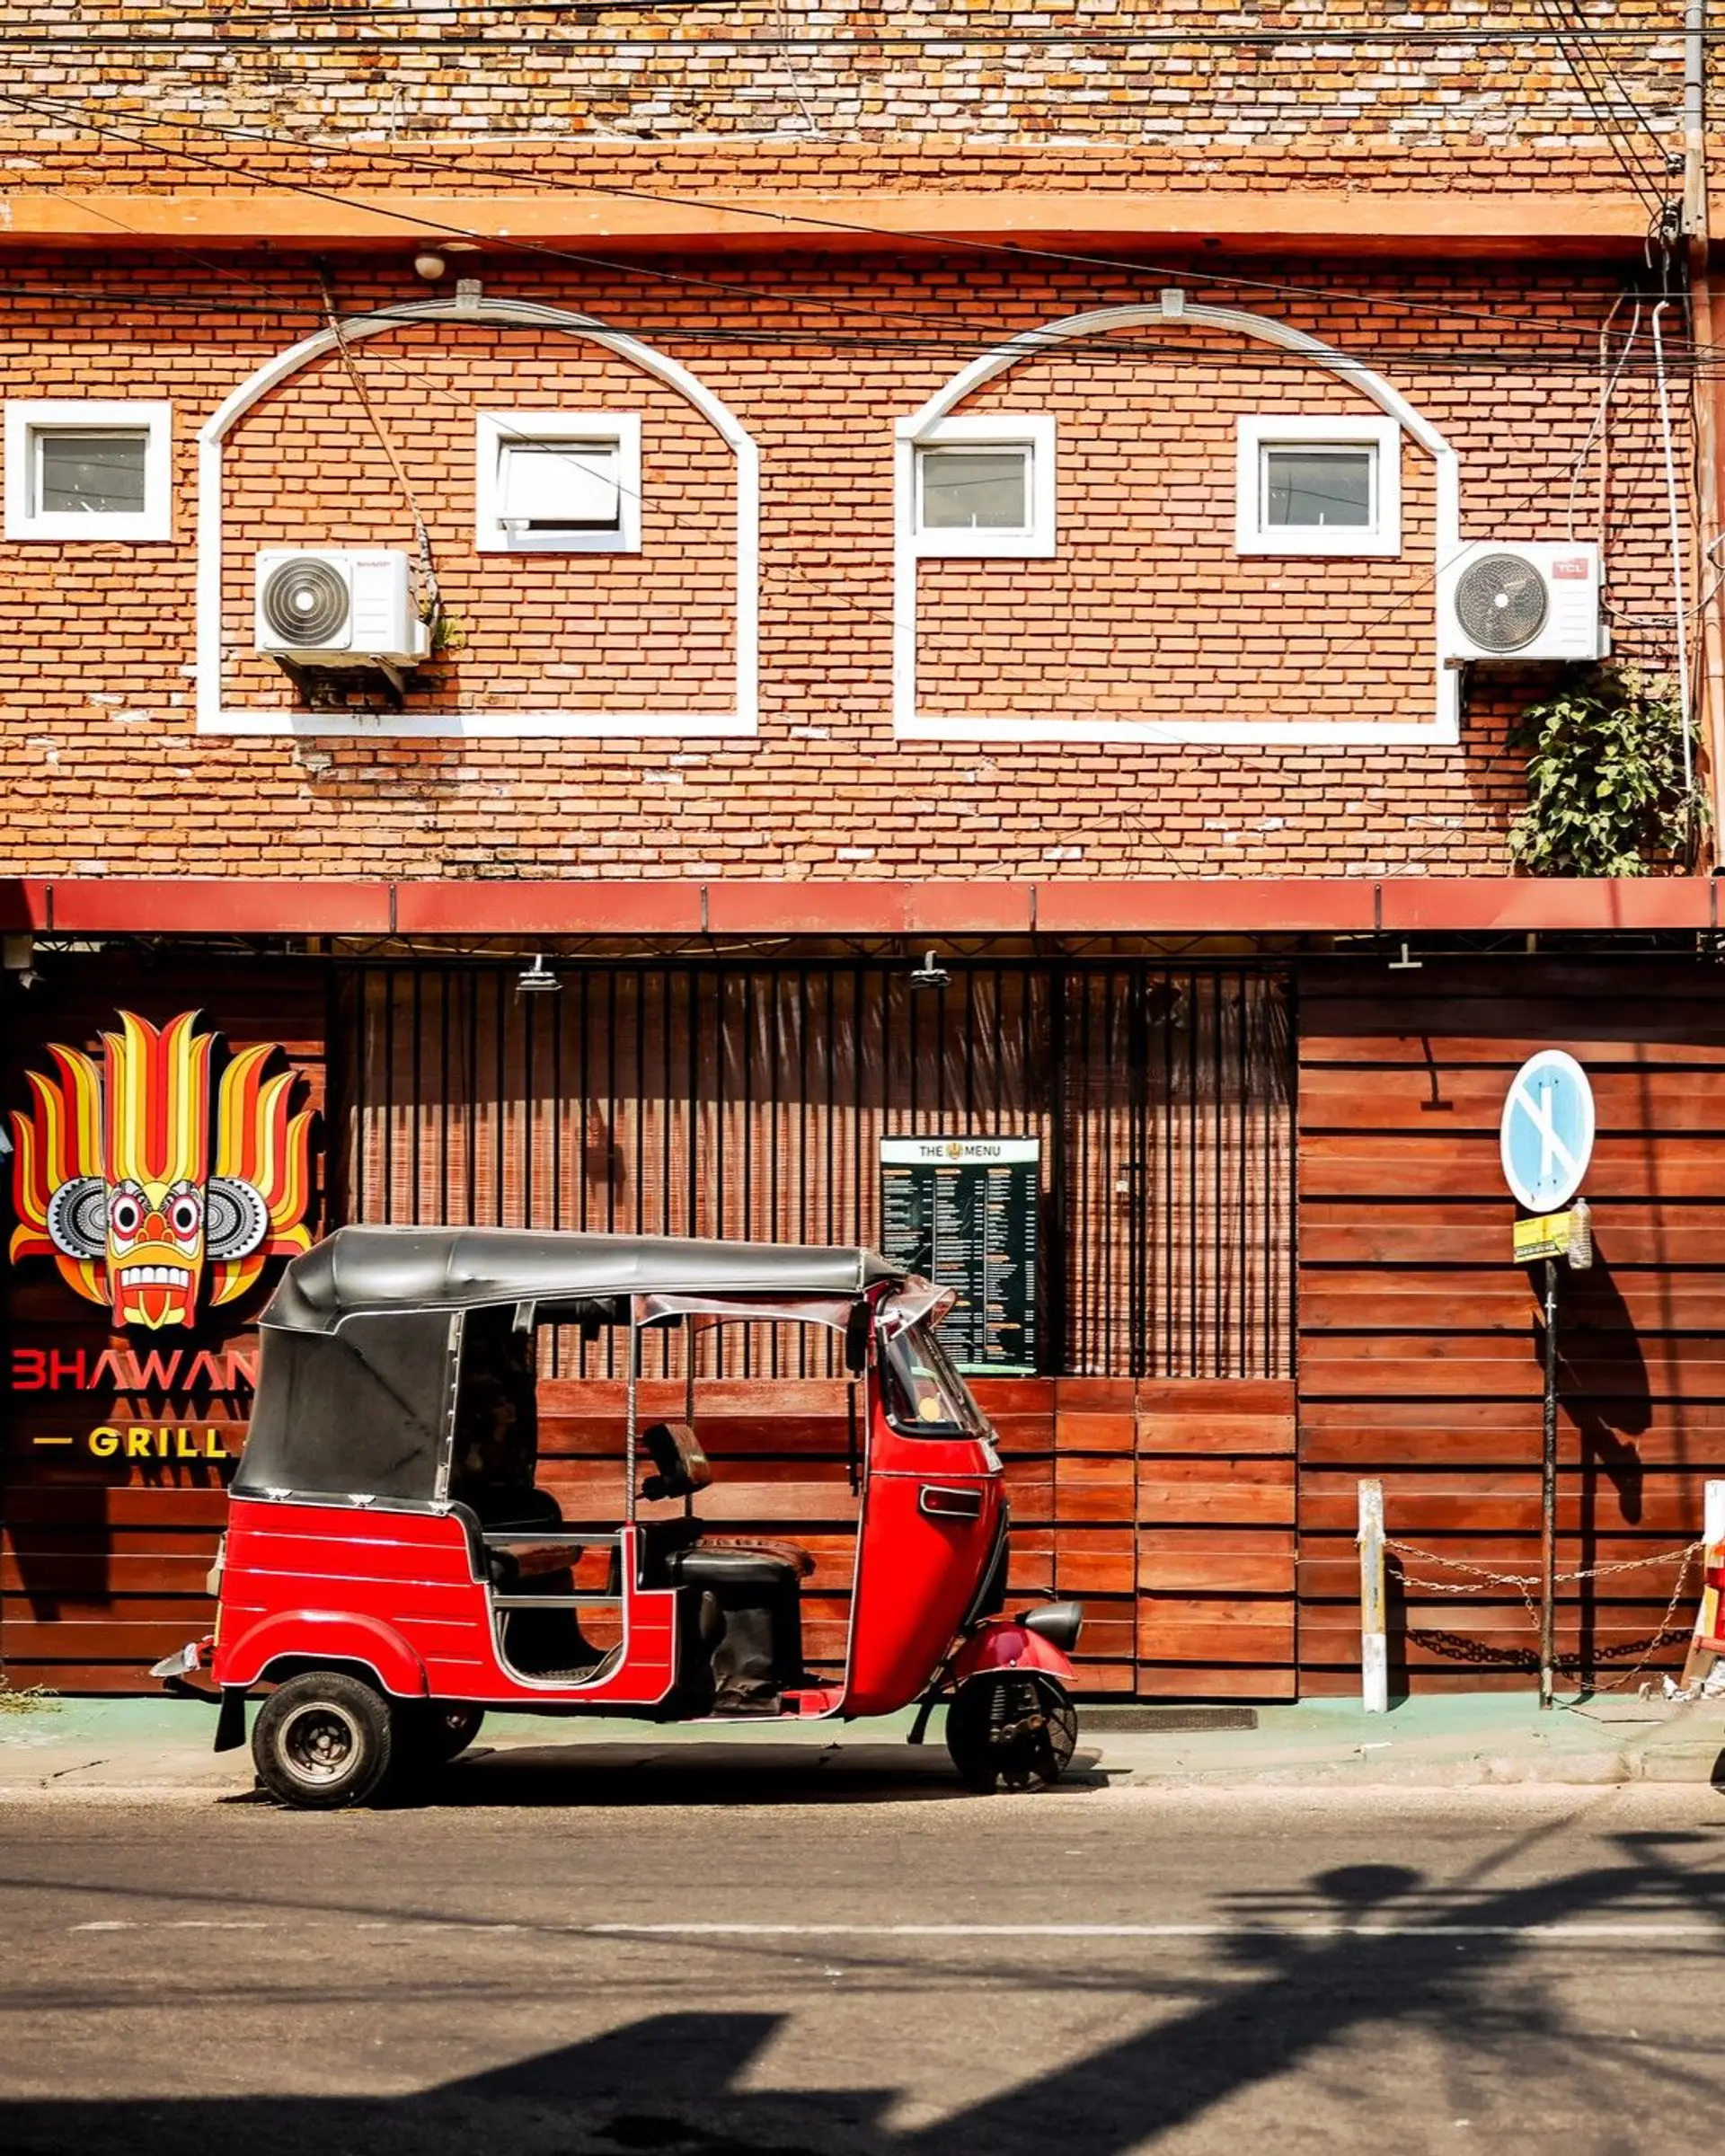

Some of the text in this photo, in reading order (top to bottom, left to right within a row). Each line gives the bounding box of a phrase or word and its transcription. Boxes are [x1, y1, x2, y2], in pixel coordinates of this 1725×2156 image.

[919, 1145, 1001, 1157] THE MENU
[88, 1427, 226, 1458] GRILL
